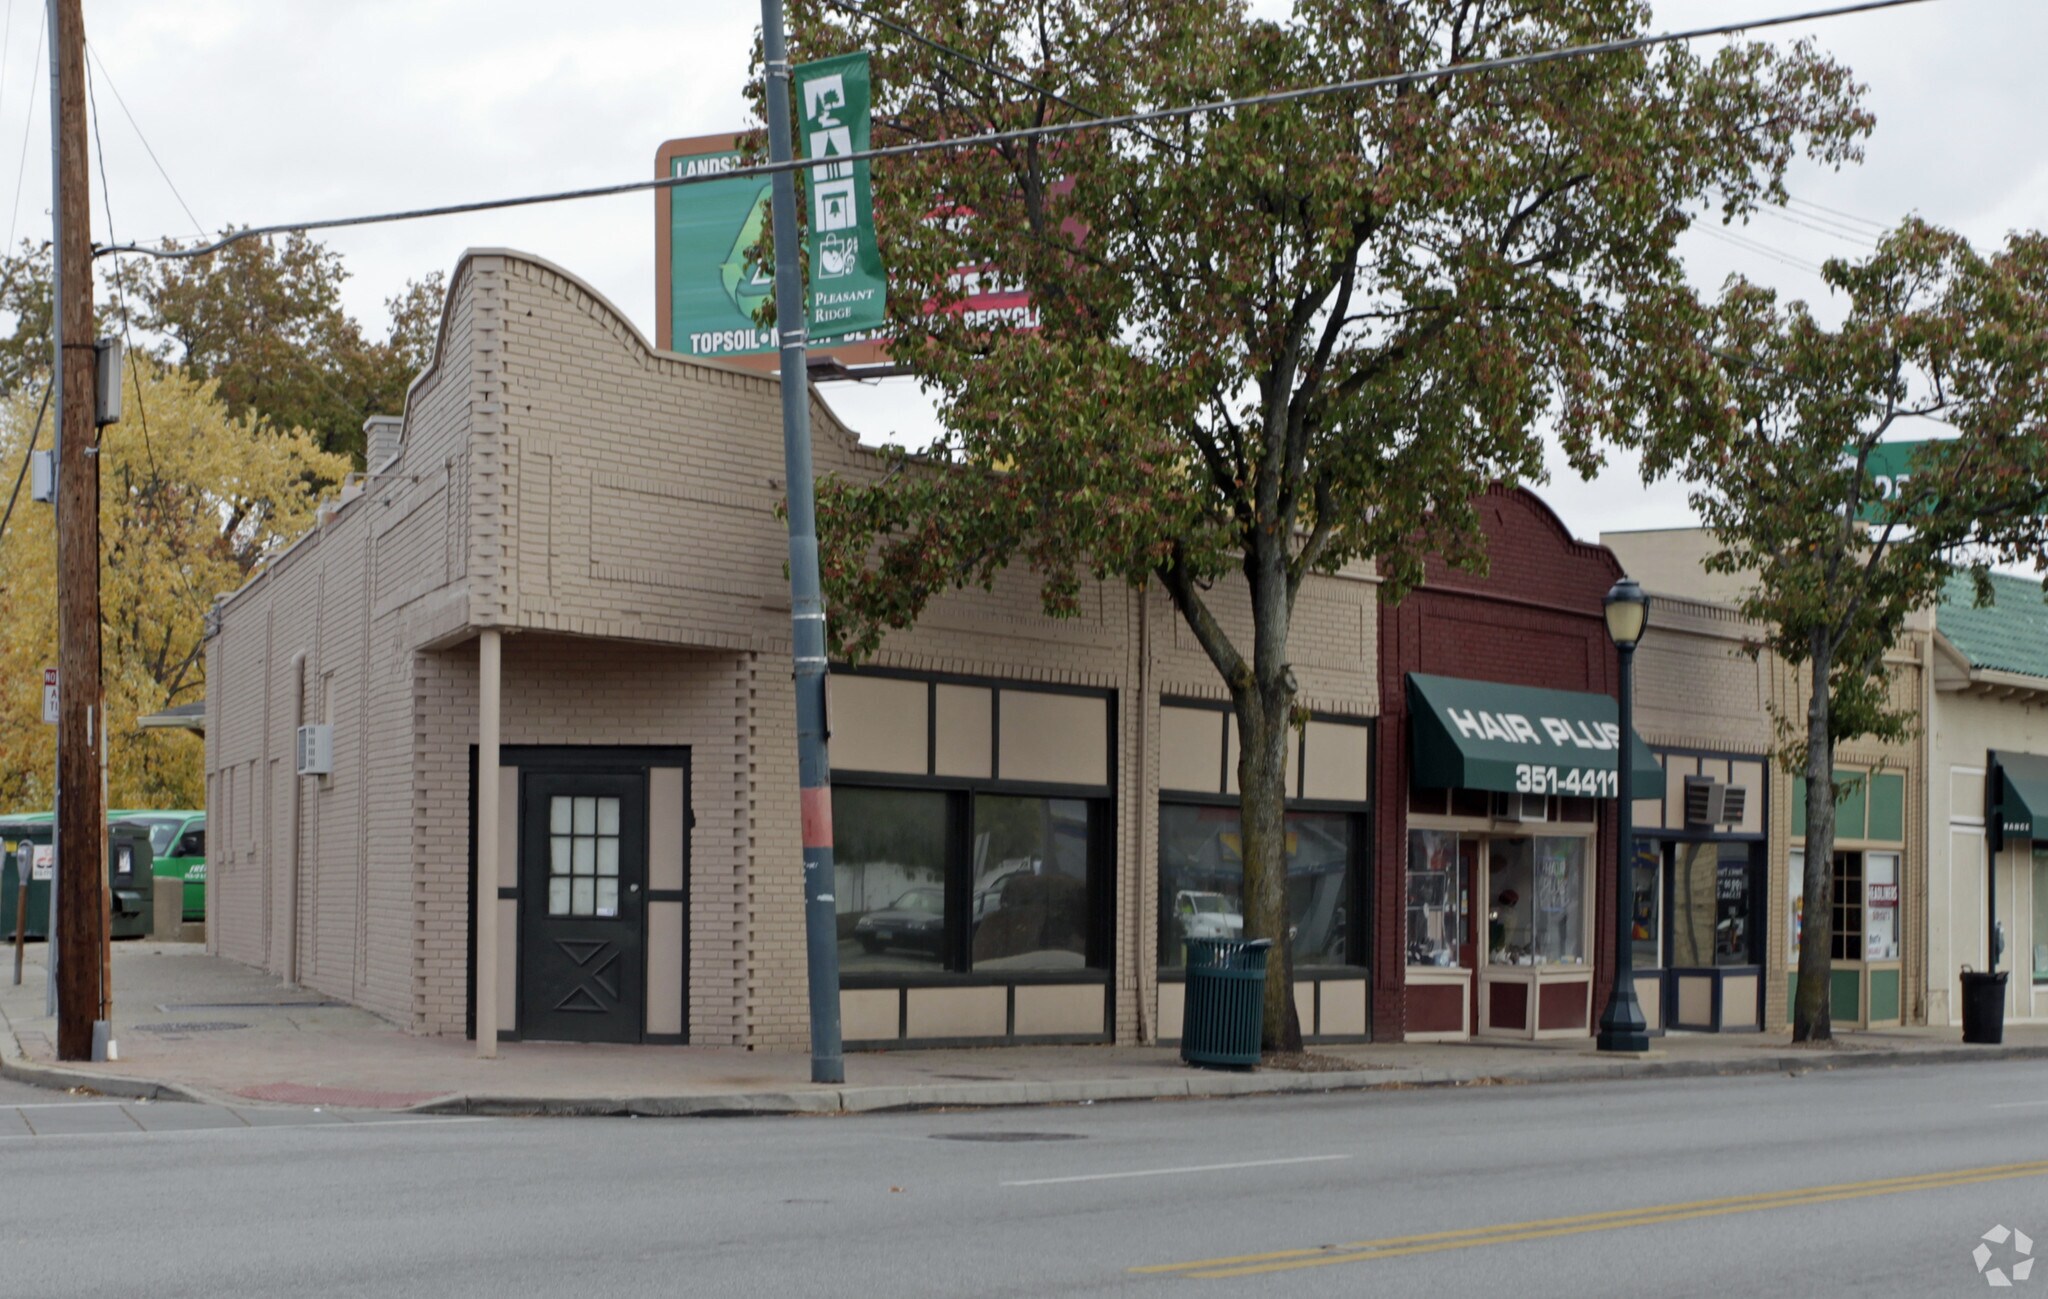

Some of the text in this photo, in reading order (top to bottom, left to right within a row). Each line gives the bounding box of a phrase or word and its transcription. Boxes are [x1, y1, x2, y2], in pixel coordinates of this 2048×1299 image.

[815, 289, 875, 307] PLEASANT
[815, 307, 852, 323] RIDGE
[690, 328, 760, 355] TOPSOIL
[45, 671, 56, 683] NO
[1447, 707, 1619, 750] HAIR PLUS
[1516, 764, 1618, 797] 351-4411
